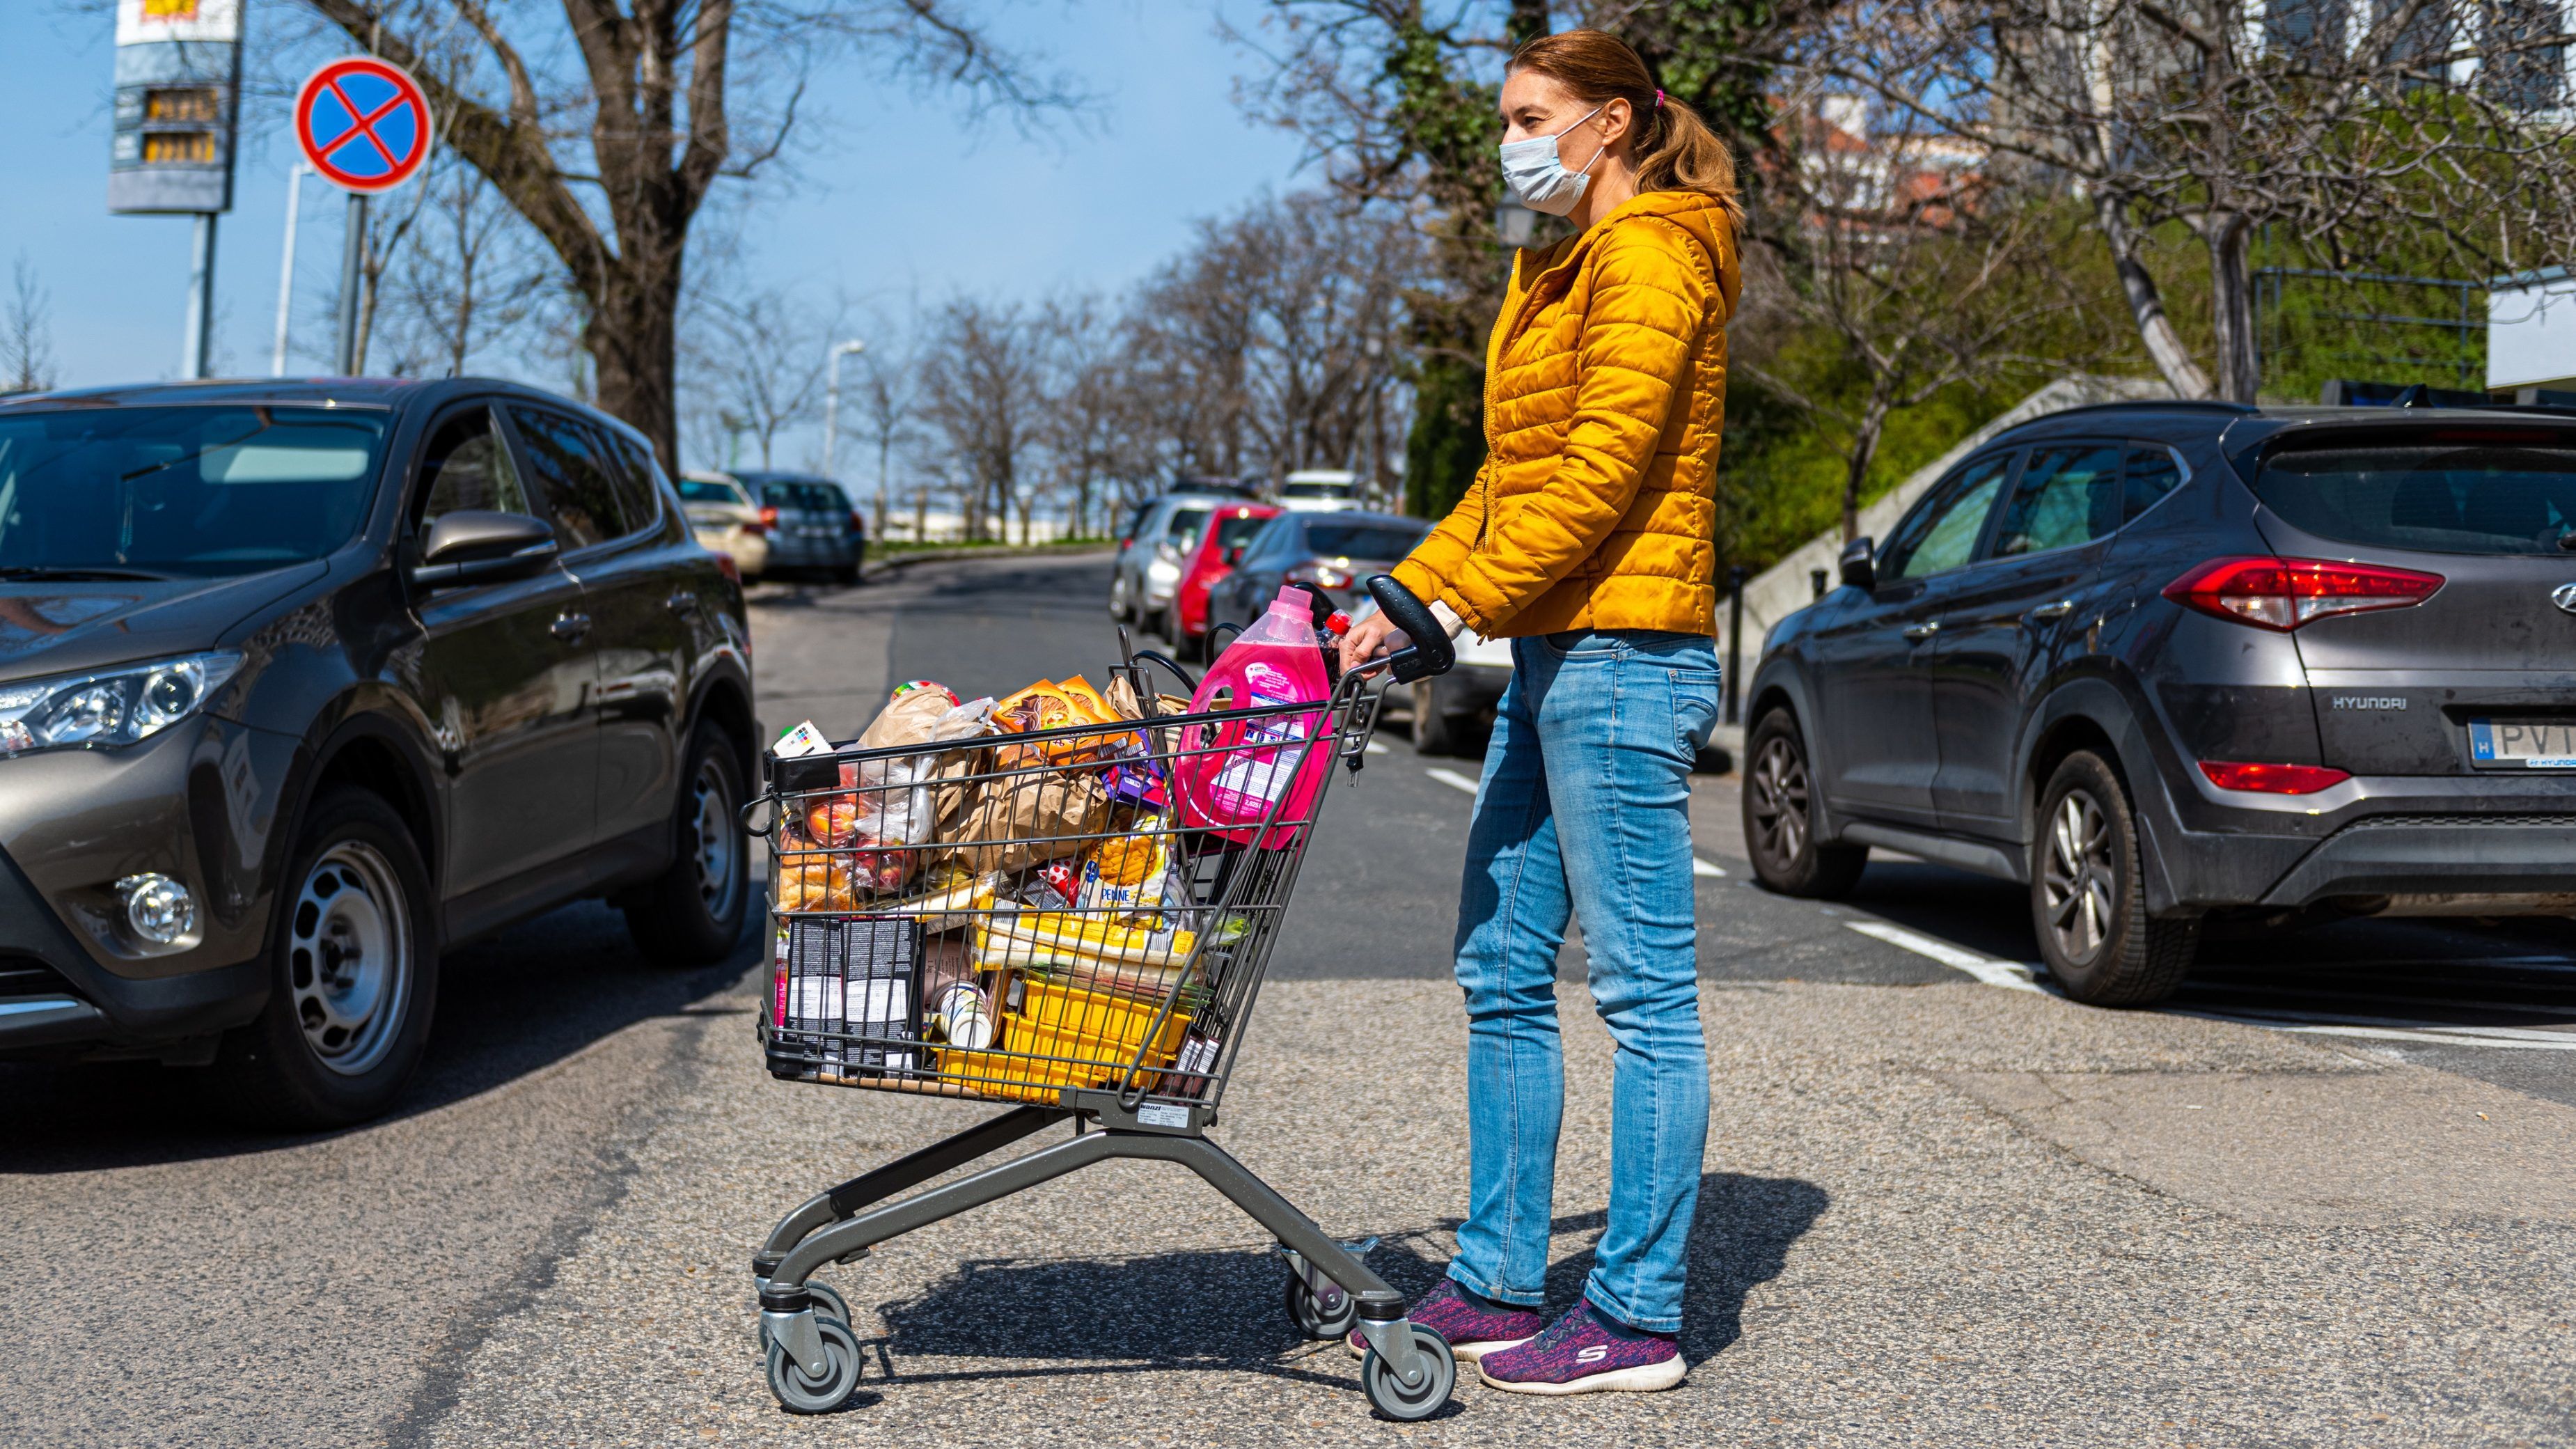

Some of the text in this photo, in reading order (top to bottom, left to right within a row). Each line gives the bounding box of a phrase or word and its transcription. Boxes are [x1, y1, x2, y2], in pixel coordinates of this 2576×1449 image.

[2333, 696, 2407, 710] HYUNDAI
[2479, 742, 2489, 753] H
[1101, 888, 1129, 901] PENNE
